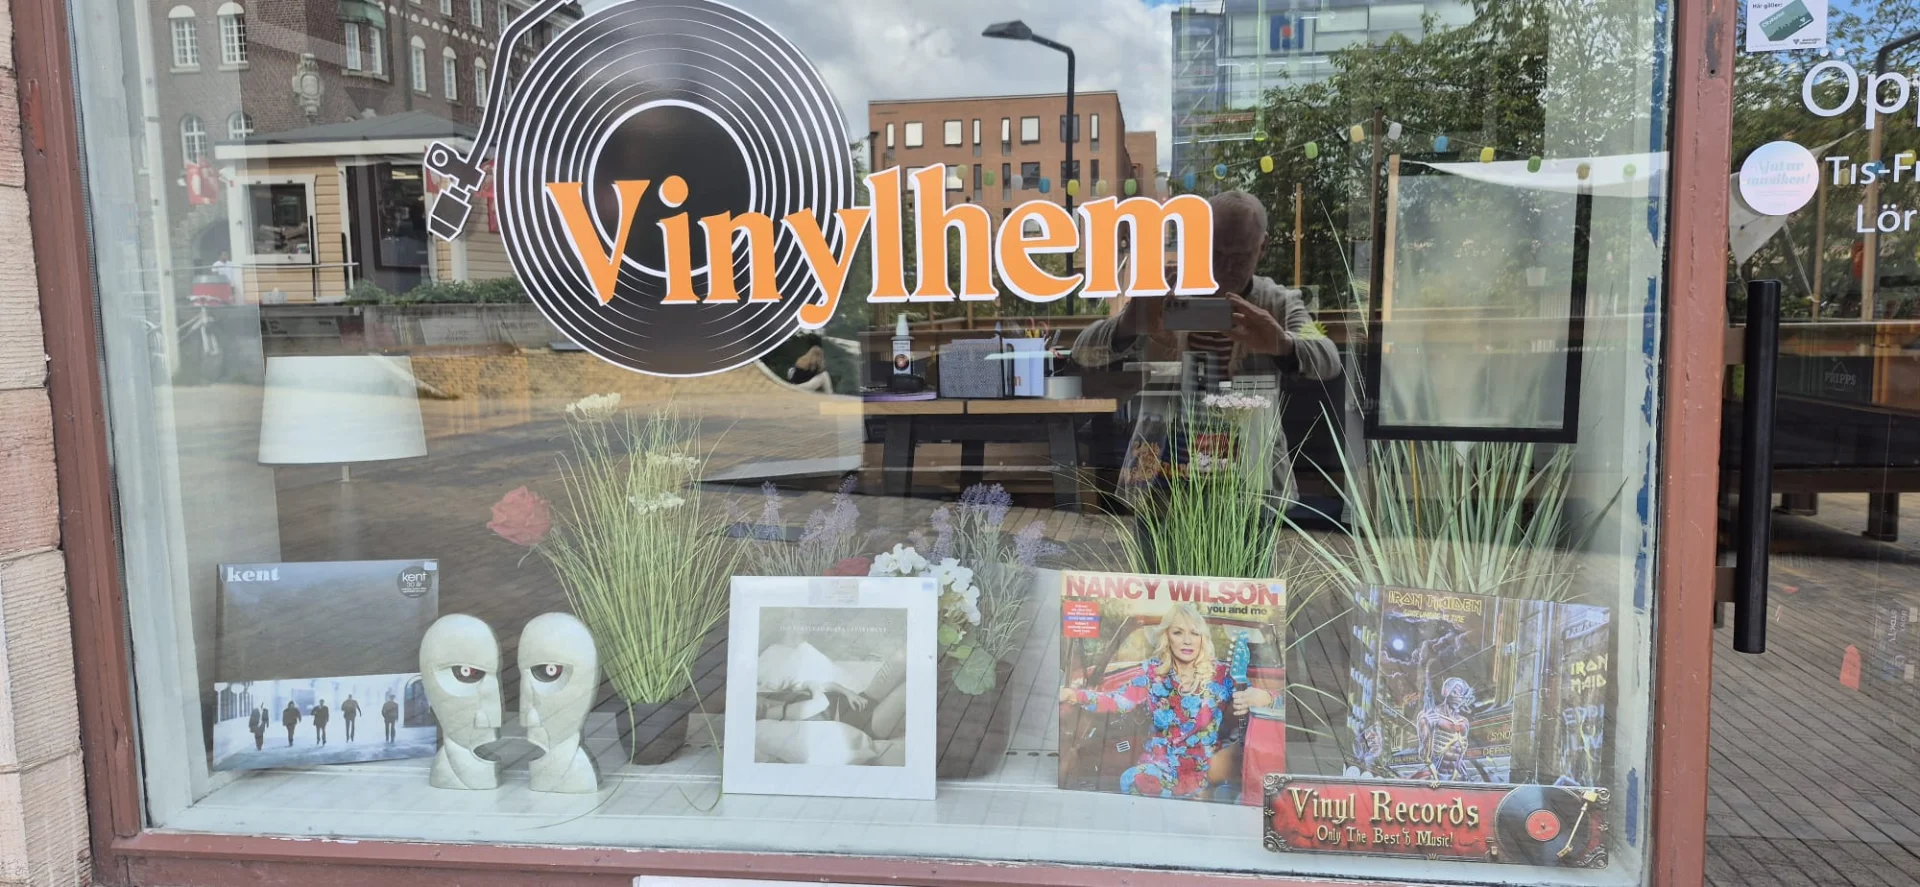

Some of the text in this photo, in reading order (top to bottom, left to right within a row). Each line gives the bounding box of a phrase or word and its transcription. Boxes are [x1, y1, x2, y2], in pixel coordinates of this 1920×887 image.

[1802, 47, 1920, 131] Öp
[1856, 203, 1918, 234] Lör
[545, 162, 1219, 330] Vinylhem
[226, 566, 281, 582] kent
[402, 571, 429, 582] kent
[1066, 575, 1279, 606] NANCY WILSON
[1388, 590, 1482, 616] IRON MAIDEN
[1206, 604, 1268, 615] you and me
[1570, 652, 1608, 677] IRON
[1570, 673, 1607, 695] MAID
[1286, 786, 1480, 827] Vinyl Records
[1316, 825, 1341, 843] Only
[1346, 826, 1368, 843] The
[1372, 827, 1400, 844] Best
[1416, 830, 1455, 848] Music!
